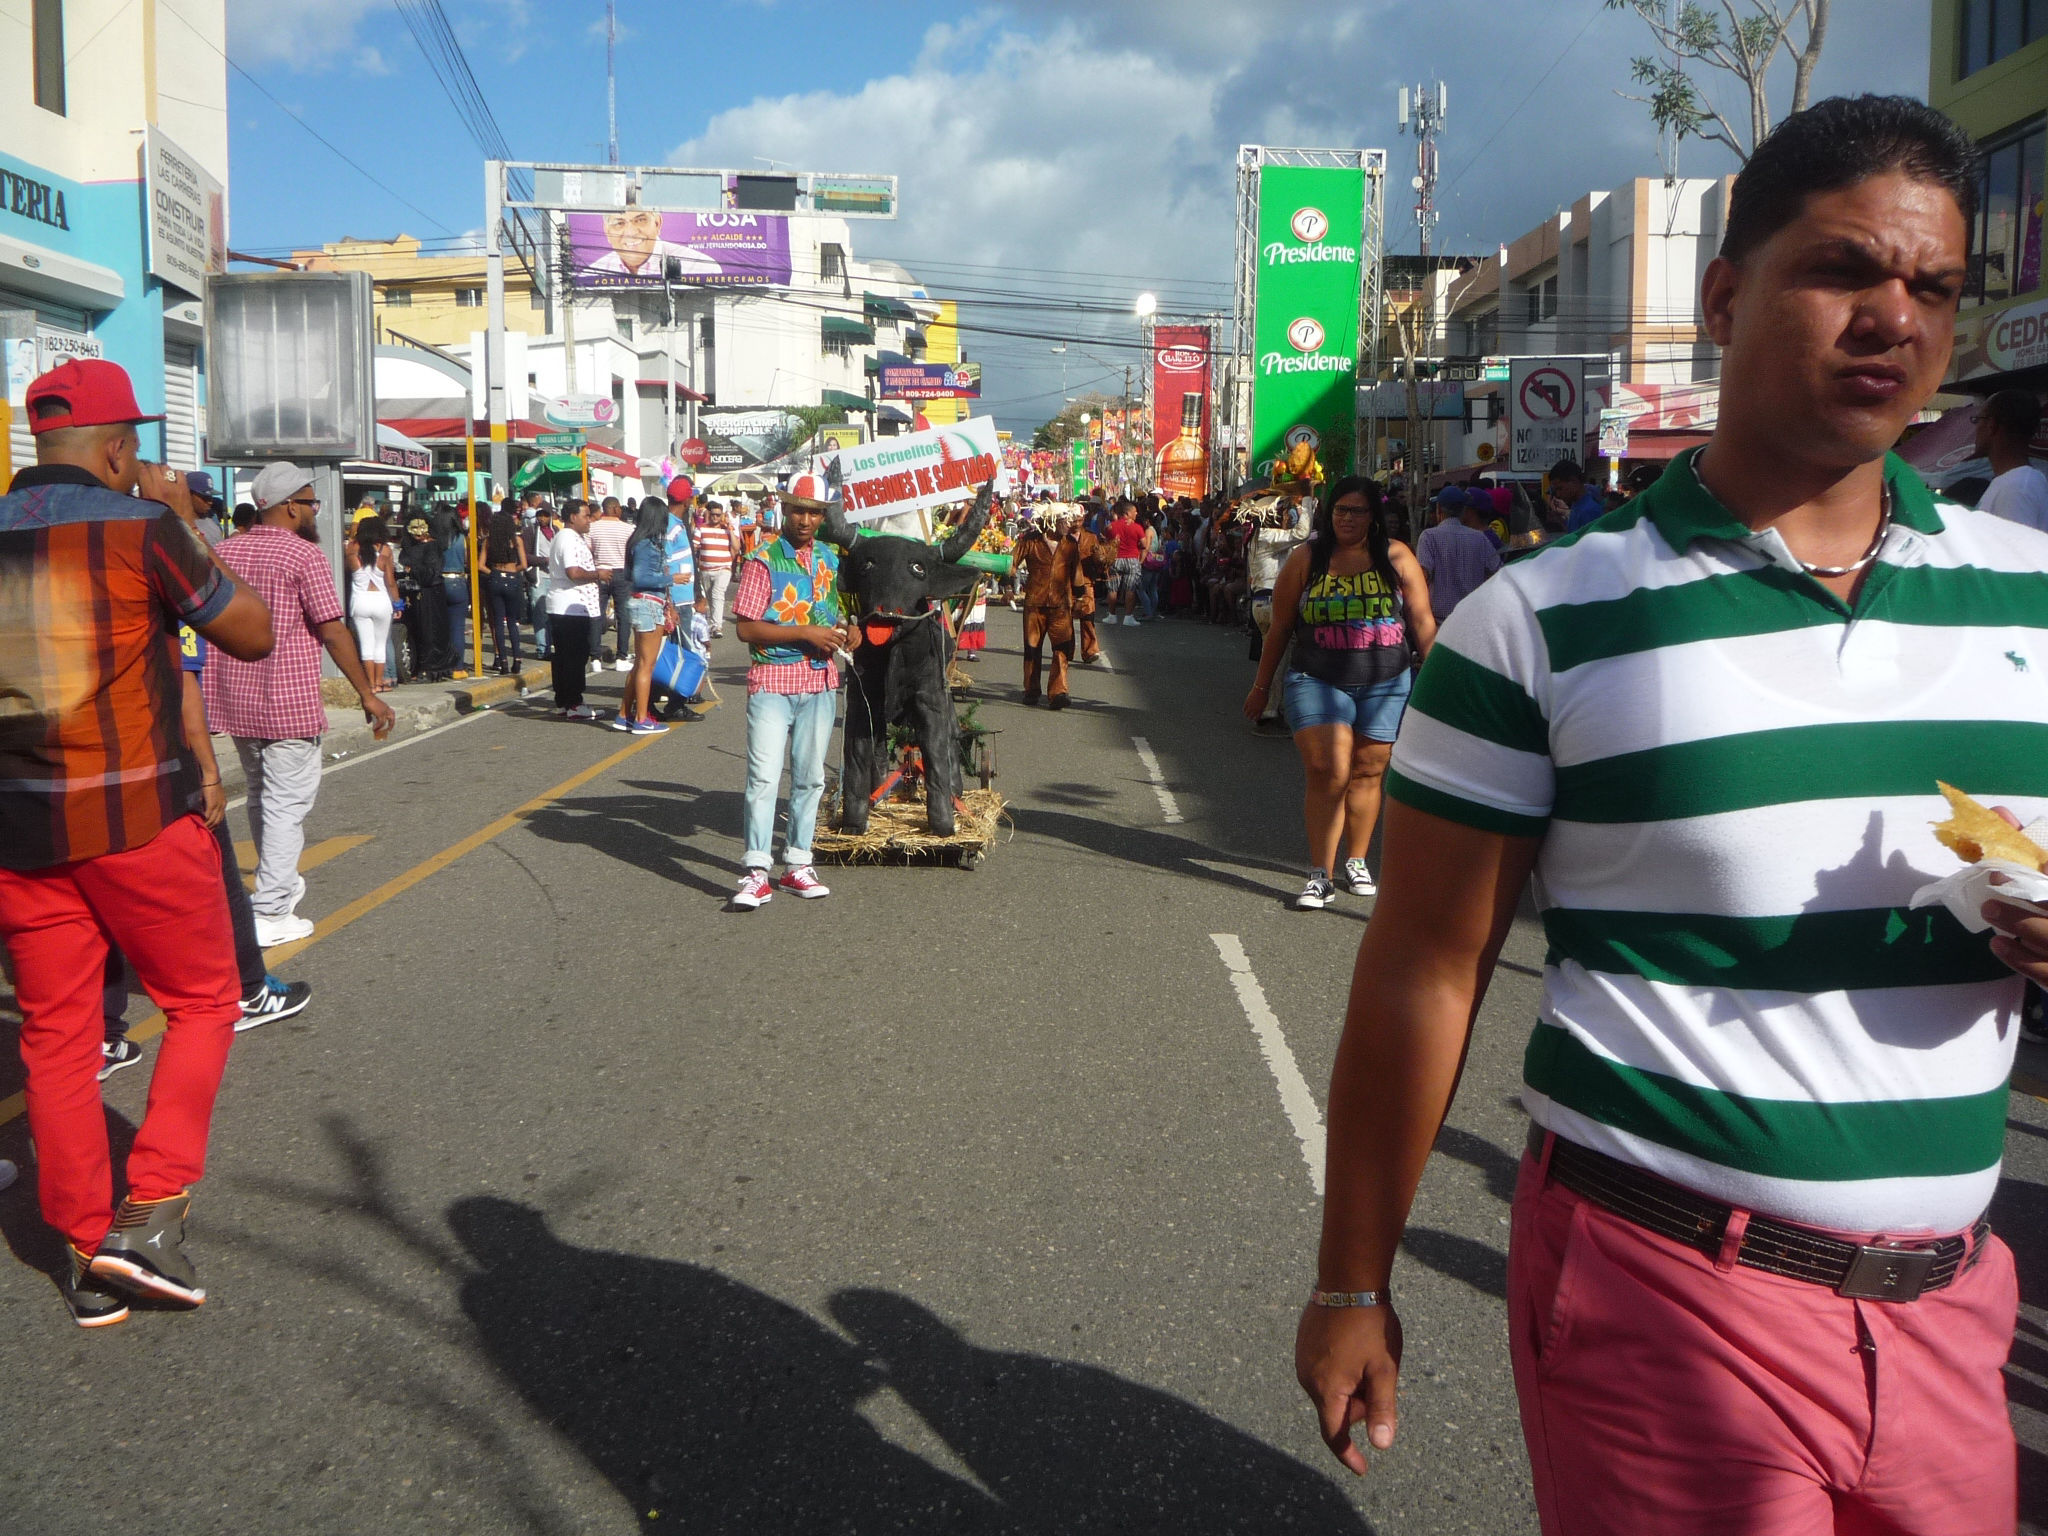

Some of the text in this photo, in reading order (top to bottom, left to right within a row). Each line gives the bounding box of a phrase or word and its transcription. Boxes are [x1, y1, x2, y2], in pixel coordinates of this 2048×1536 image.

[156, 188, 205, 237] CONSTRUIR
[696, 213, 758, 227] ROSA
[1263, 241, 1356, 267] Presidente
[705, 275, 769, 283] MERECEMOS
[1260, 352, 1353, 376] Presidente
[706, 427, 713, 436] Y
[1516, 427, 1533, 444] NO
[710, 455, 743, 464] KYOCERA
[853, 442, 942, 472] Los Ciruelitos
[852, 468, 918, 509] PREGONES
[914, 465, 936, 496] DE
[932, 452, 998, 492] SANTIAGO
[264, 995, 287, 1013] N
